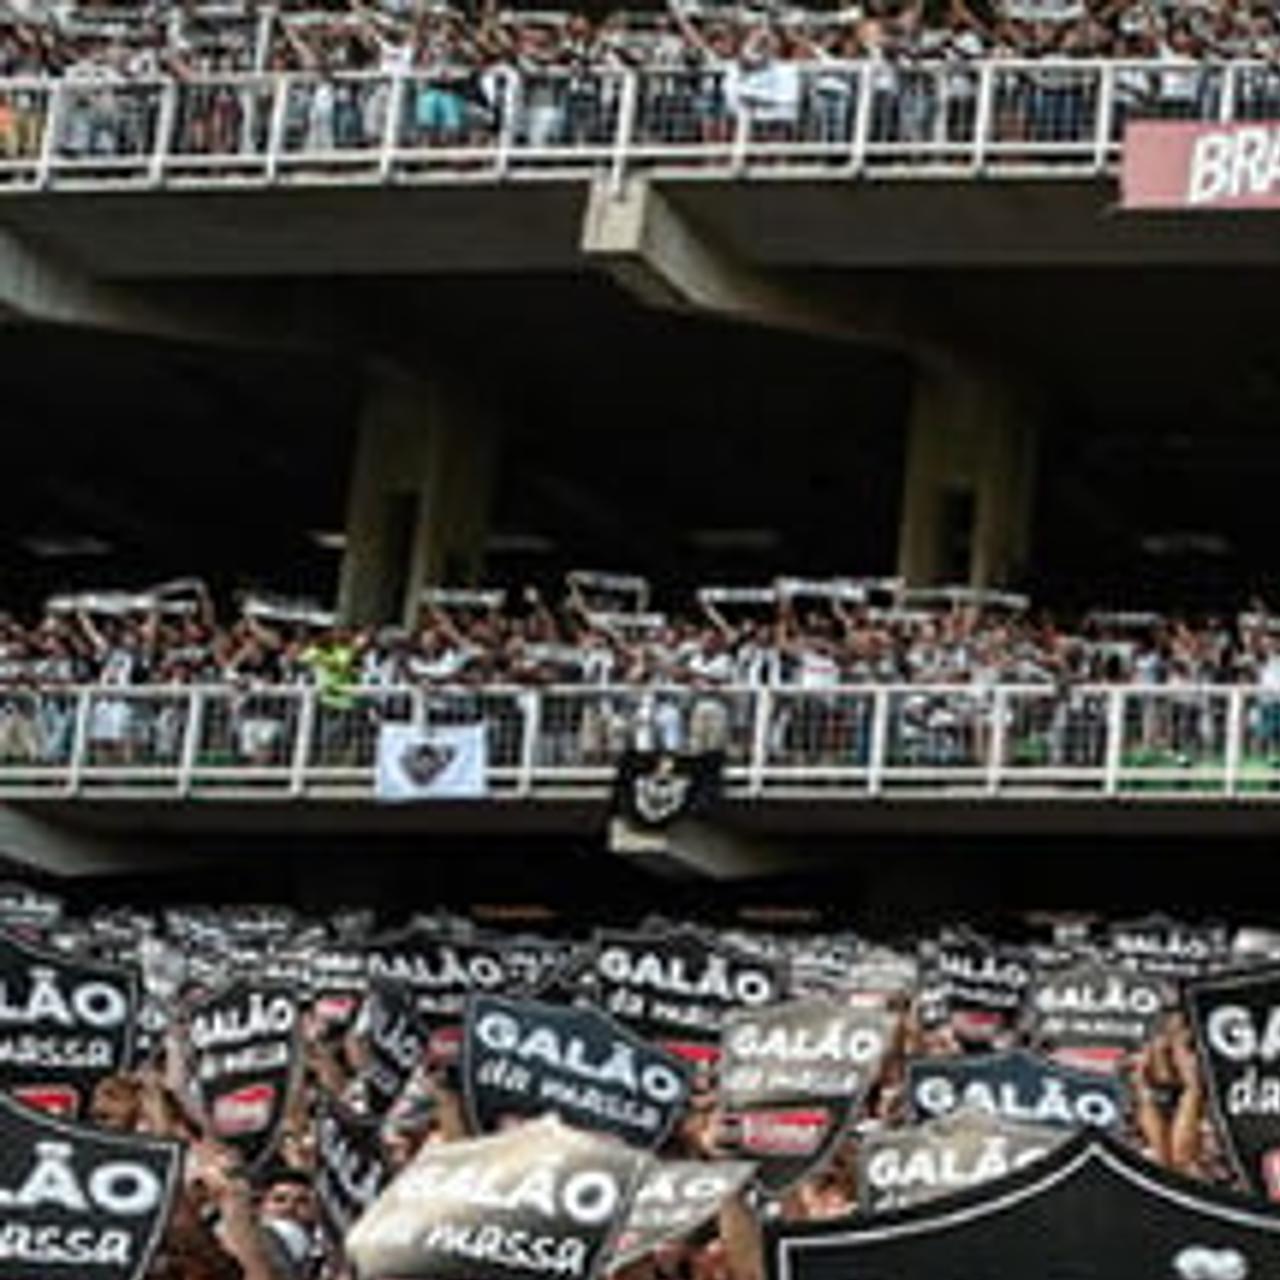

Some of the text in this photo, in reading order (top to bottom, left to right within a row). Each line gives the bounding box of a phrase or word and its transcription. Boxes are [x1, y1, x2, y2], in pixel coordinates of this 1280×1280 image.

[601, 948, 770, 1003] GALÃO
[1036, 976, 1160, 1014] GALÃO
[476, 1012, 683, 1101] GALÃO
[730, 1023, 881, 1062] GALÃO
[915, 1075, 1116, 1127] GALÃO
[423, 1223, 584, 1275] massa
